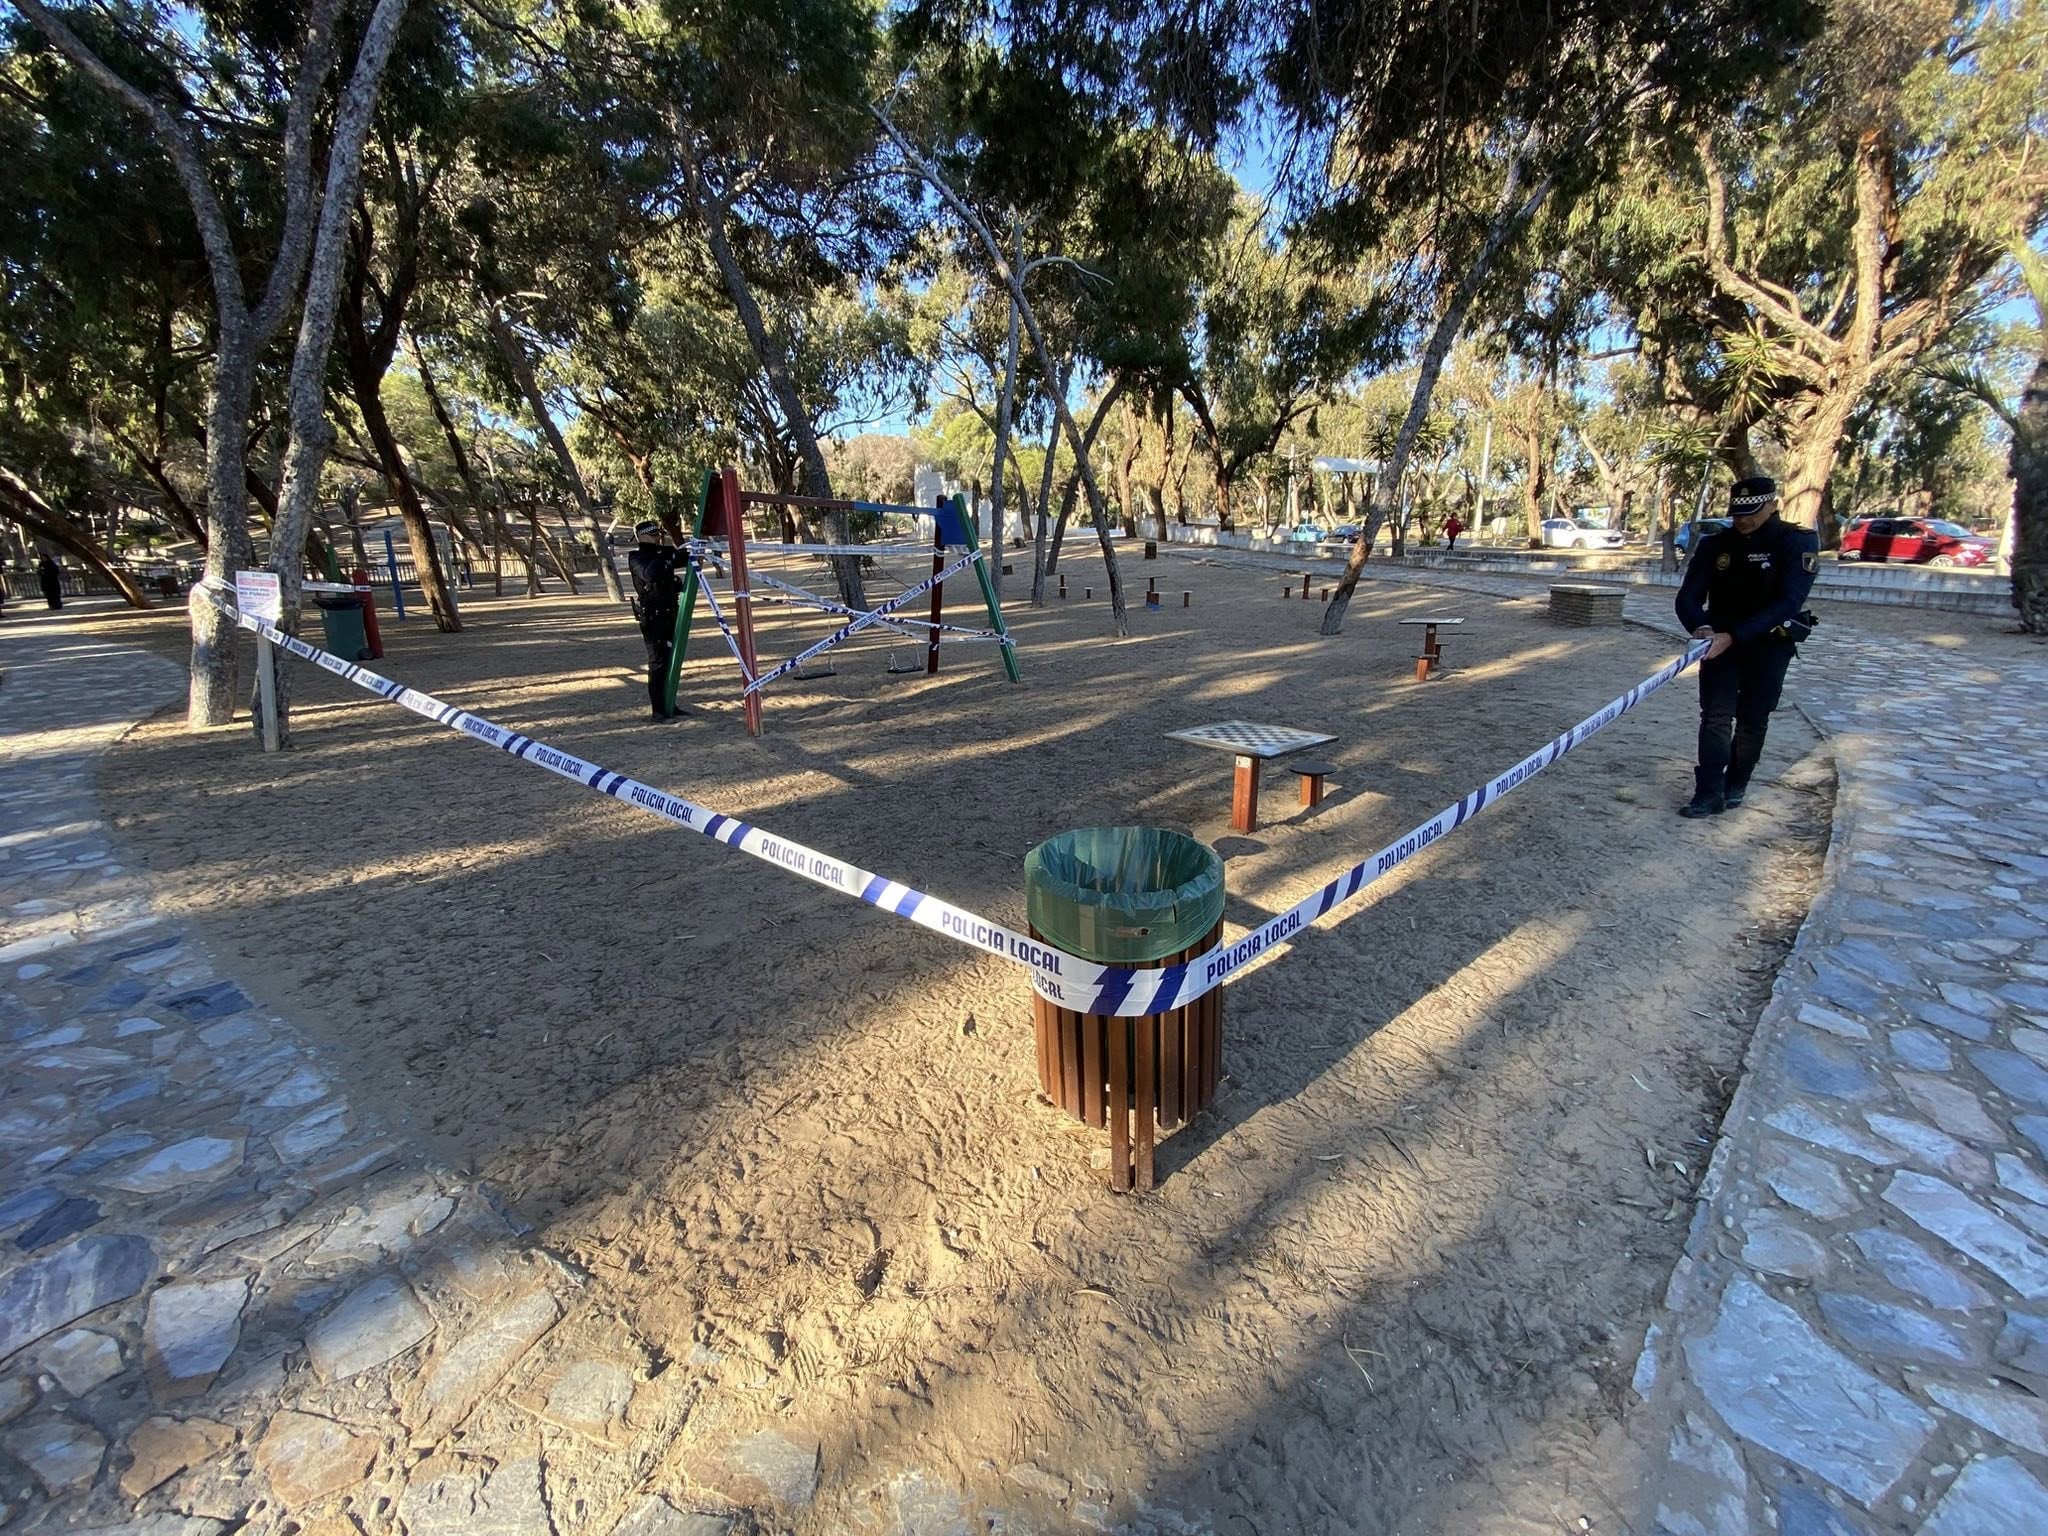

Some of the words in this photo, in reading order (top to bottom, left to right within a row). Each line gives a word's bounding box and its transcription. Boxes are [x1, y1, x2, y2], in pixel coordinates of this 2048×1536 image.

[462, 716, 483, 738] POLICIA
[482, 724, 501, 742] LOCAL
[535, 747, 562, 768] POLICIA
[561, 755, 584, 778] LOCAL
[1496, 768, 1524, 798] POLICIA
[1524, 754, 1543, 778] LOCAL
[631, 786, 666, 813] POLICIA
[665, 799, 694, 824] LOCAL
[761, 837, 806, 872] POLICIA
[809, 857, 845, 888] LOCAL
[1377, 836, 1416, 875] POLICIA
[1416, 818, 1443, 851] LOCAL
[942, 909, 1005, 954] POLICIA
[1009, 936, 1064, 977] LOCAL
[1206, 936, 1262, 983] POLICIA
[1264, 909, 1303, 946] LOCAL
